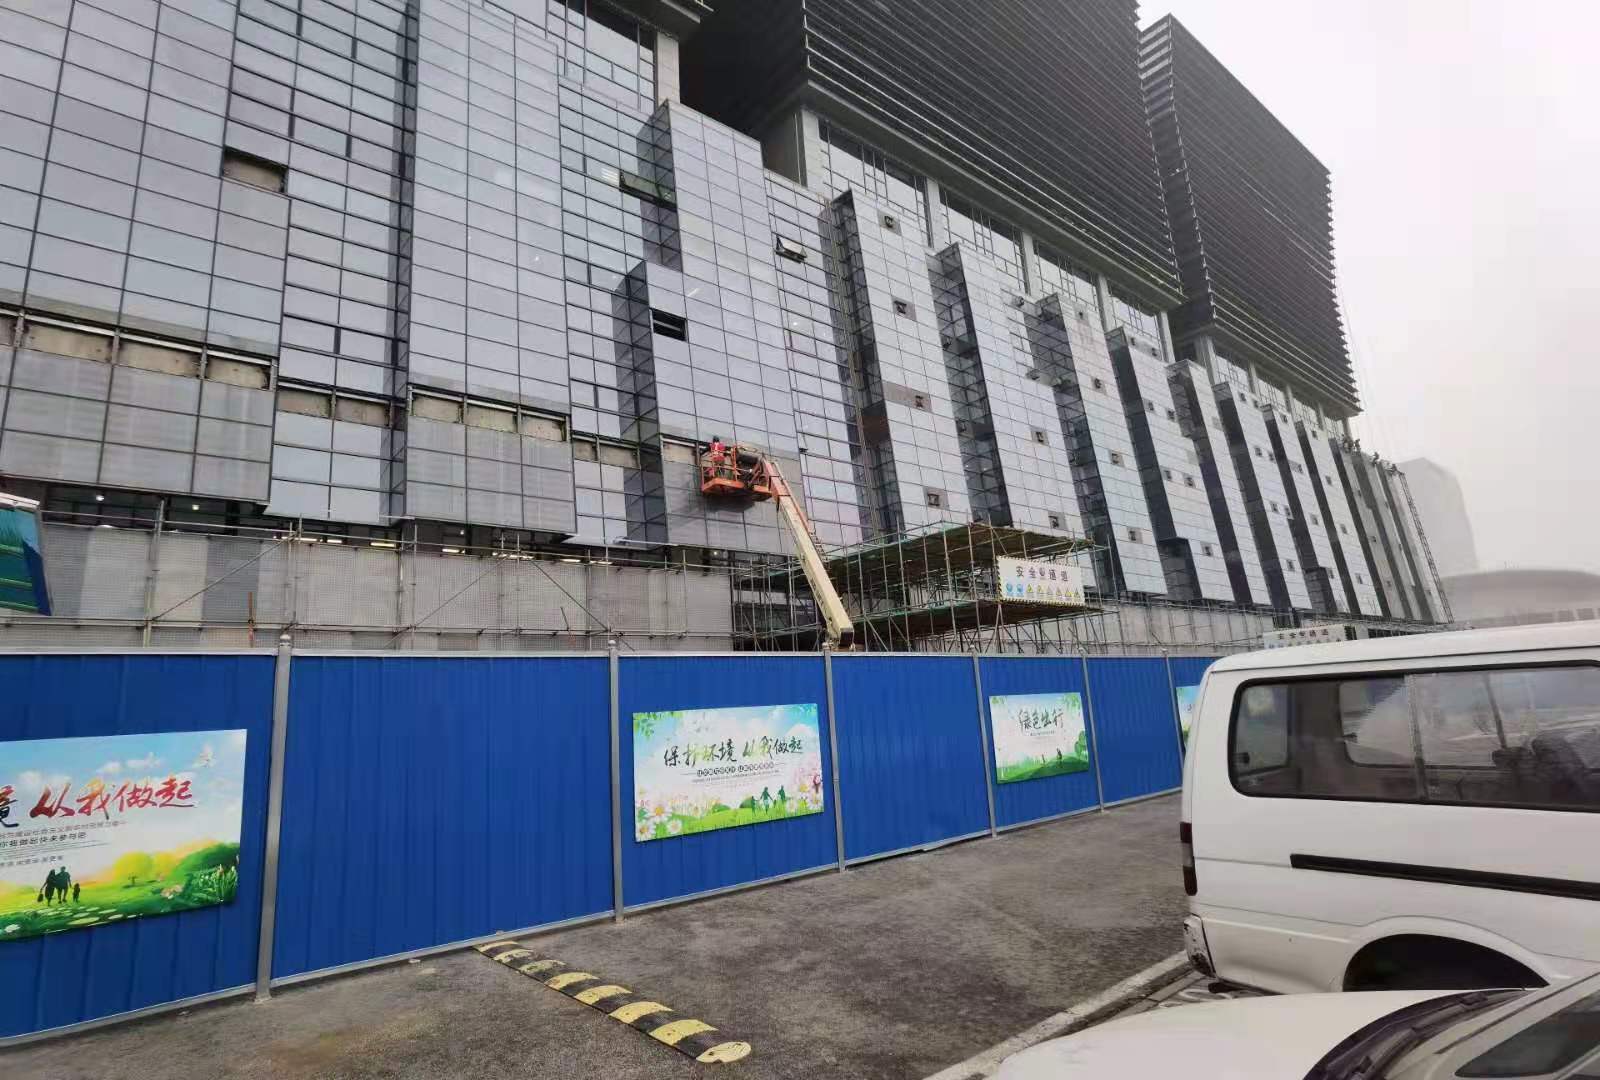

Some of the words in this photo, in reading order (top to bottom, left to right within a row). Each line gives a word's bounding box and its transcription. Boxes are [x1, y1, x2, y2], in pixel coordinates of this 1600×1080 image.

[1018, 708, 1064, 734] 绿色出行
[663, 738, 738, 768] 保护环境
[742, 735, 804, 760] 从我做起
[29, 776, 195, 820] 从我做起
